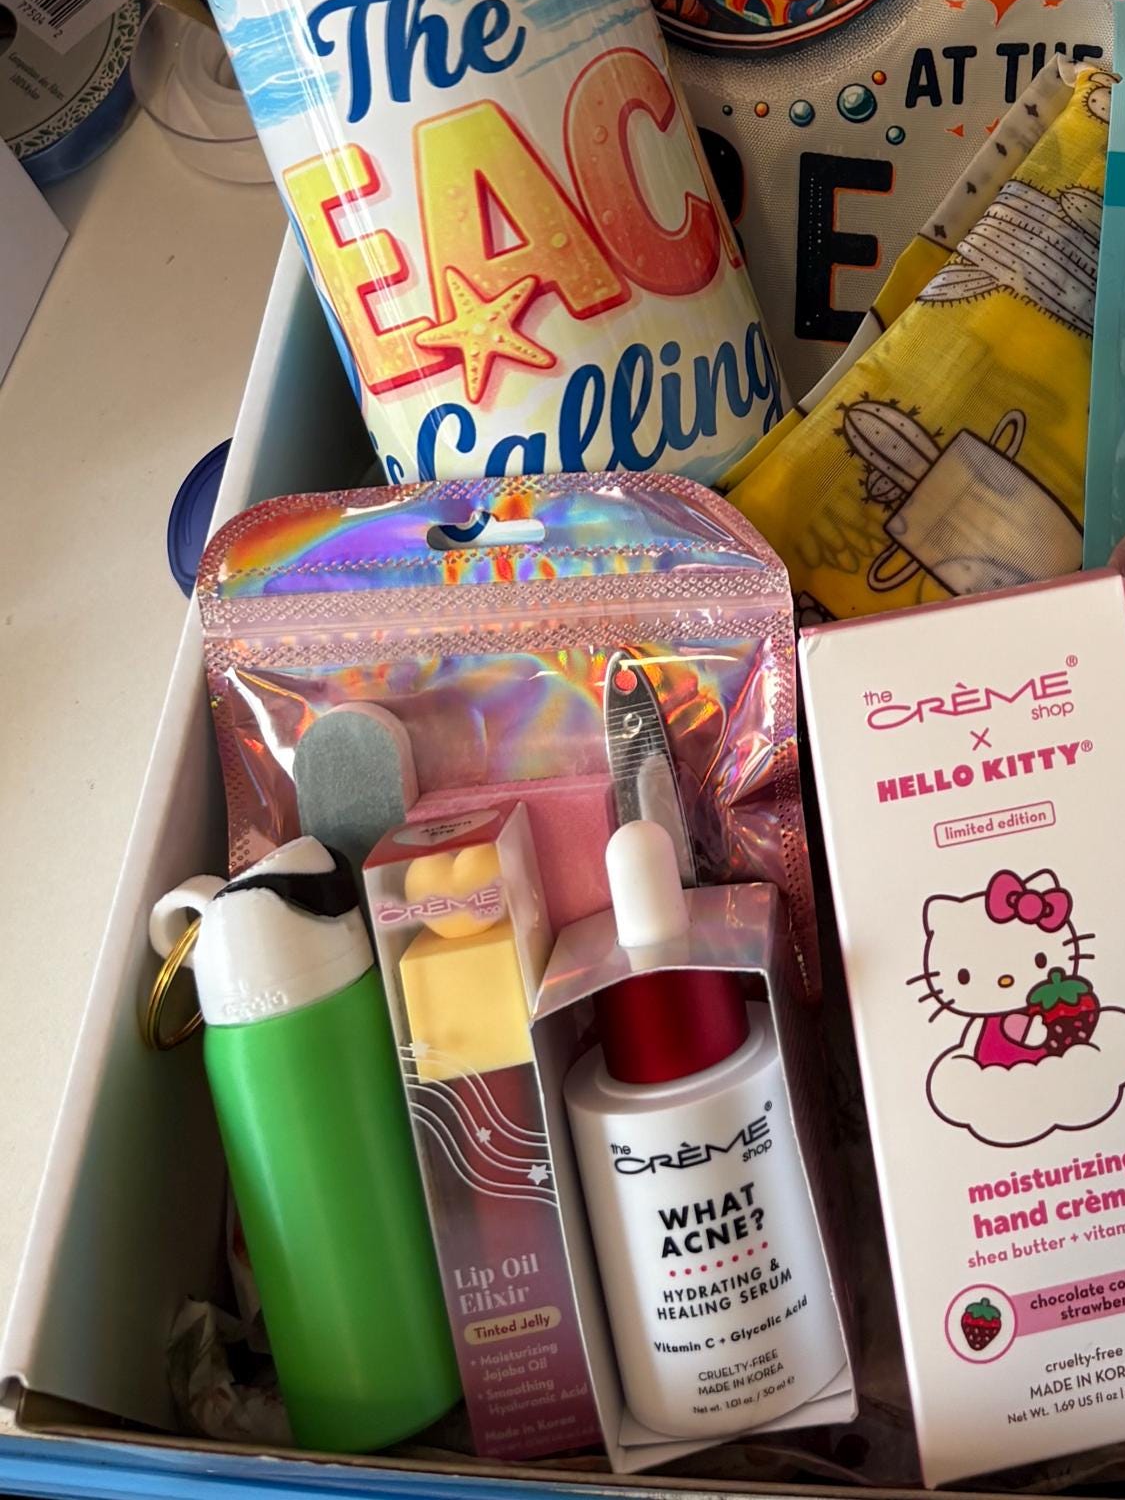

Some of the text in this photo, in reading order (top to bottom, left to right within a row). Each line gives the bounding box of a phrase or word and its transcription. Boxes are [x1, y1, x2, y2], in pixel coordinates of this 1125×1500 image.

[904, 45, 978, 109] AT
[281, 46, 725, 395] EAC
[863, 688, 893, 707] the
[867, 670, 1073, 731] CRÈME
[1031, 699, 1075, 722] shop
[876, 763, 975, 803] HELLO
[944, 809, 1048, 841] limited edition
[610, 1142, 632, 1156] the
[614, 1115, 771, 1176] CRÈME
[742, 1138, 773, 1163] shop
[658, 1182, 756, 1231] WHAT
[973, 1200, 1049, 1240] hand
[661, 1207, 765, 1259] ACNE?
[968, 1249, 1008, 1269] shea
[1012, 1235, 1067, 1260] butter
[453, 1253, 540, 1290] Lip Oil
[663, 1257, 781, 1304] HYDRATING &
[458, 1284, 531, 1316] Elixir
[656, 1268, 793, 1321] HEALING SERUM
[1030, 1285, 1106, 1311] chocolate
[473, 1312, 551, 1341] Tinted Jelly
[654, 1341, 702, 1354] Vitamin
[704, 1337, 716, 1350] C
[730, 1314, 783, 1342] Glycolic
[784, 1293, 809, 1320] Acid
[480, 1342, 559, 1367] Moisturizing
[698, 1349, 779, 1381] CRUELTY-FREE
[1045, 1346, 1124, 1374] cruelty-free
[482, 1364, 526, 1383] Jojoba
[698, 1362, 785, 1397] MADE IN KOREA
[1030, 1377, 1073, 1401] MADE
[1076, 1372, 1093, 1388] IN
[1007, 1412, 1028, 1425] Net
[1054, 1399, 1076, 1414] 1.69
[1077, 1393, 1094, 1408] US
[1095, 1391, 1104, 1404] fl
[1106, 1391, 1118, 1401] oz
